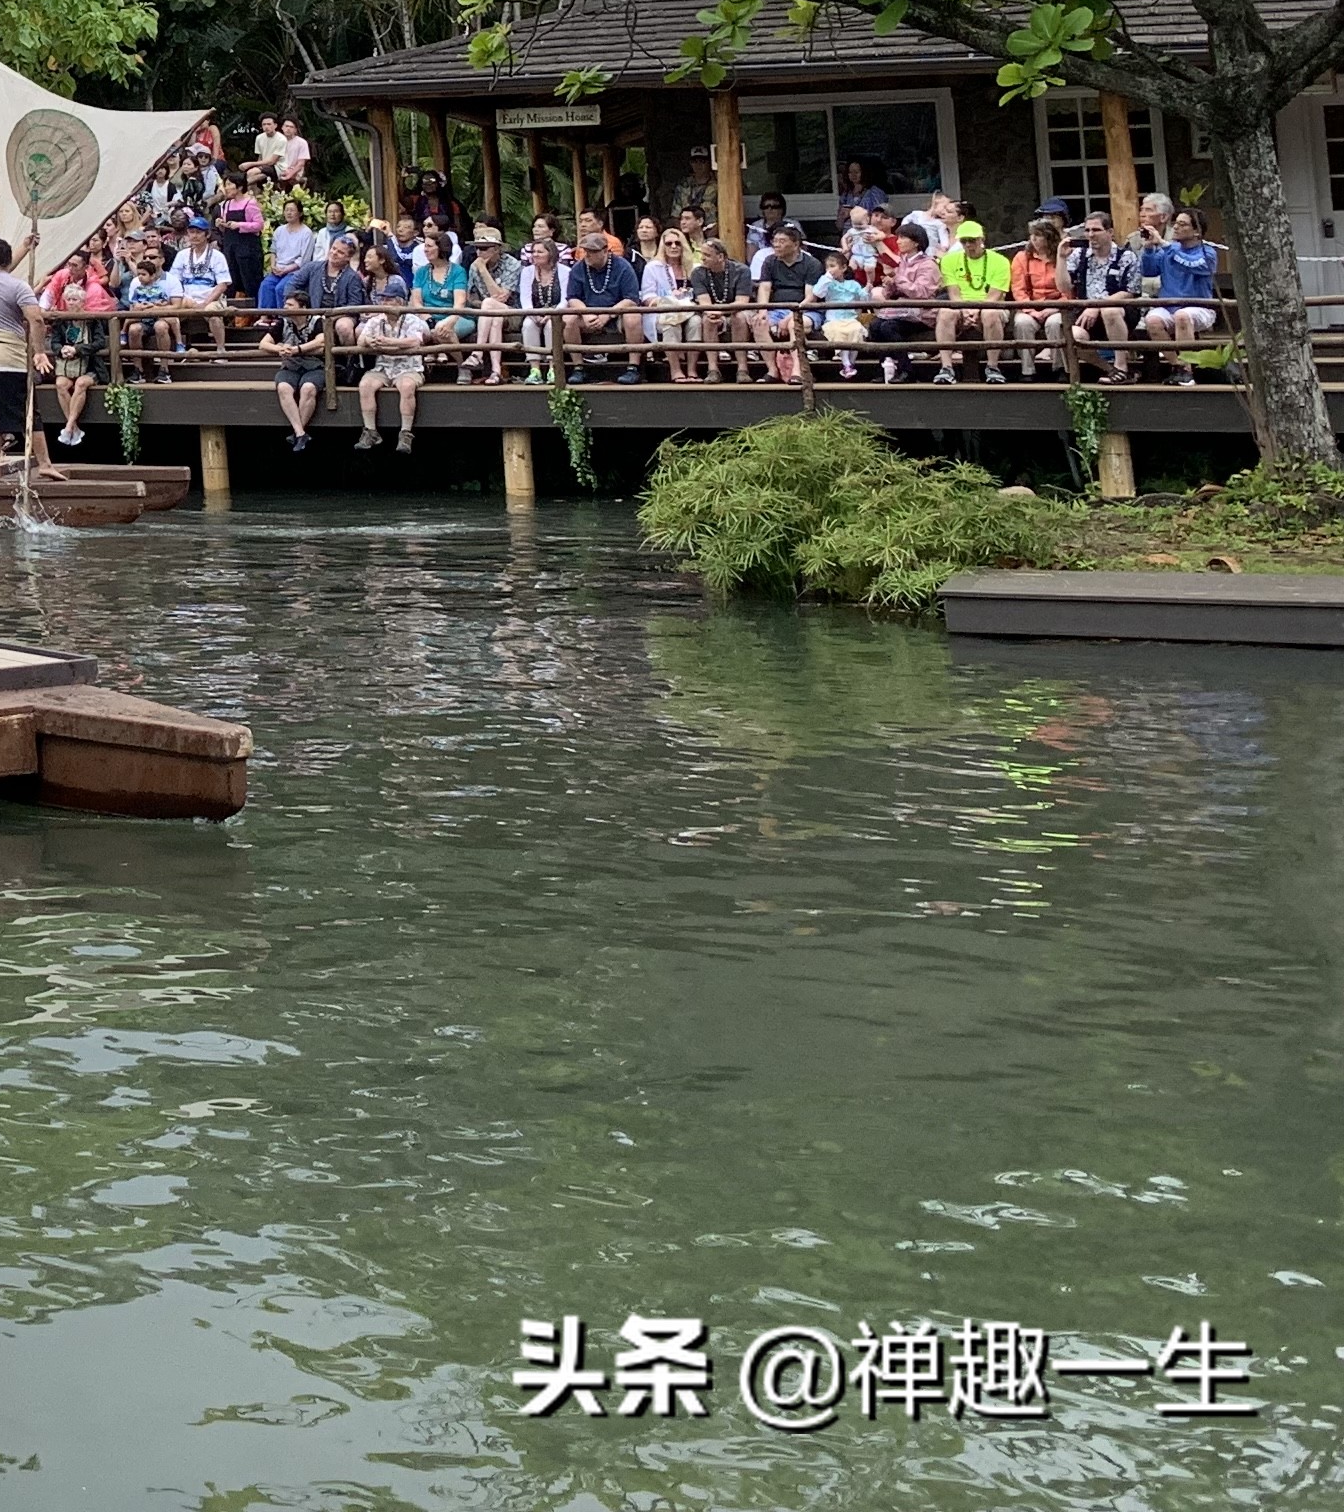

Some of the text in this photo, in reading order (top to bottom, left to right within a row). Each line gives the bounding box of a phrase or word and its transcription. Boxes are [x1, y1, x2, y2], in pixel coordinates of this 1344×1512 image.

[502, 111, 594, 127] Early Mission Home
